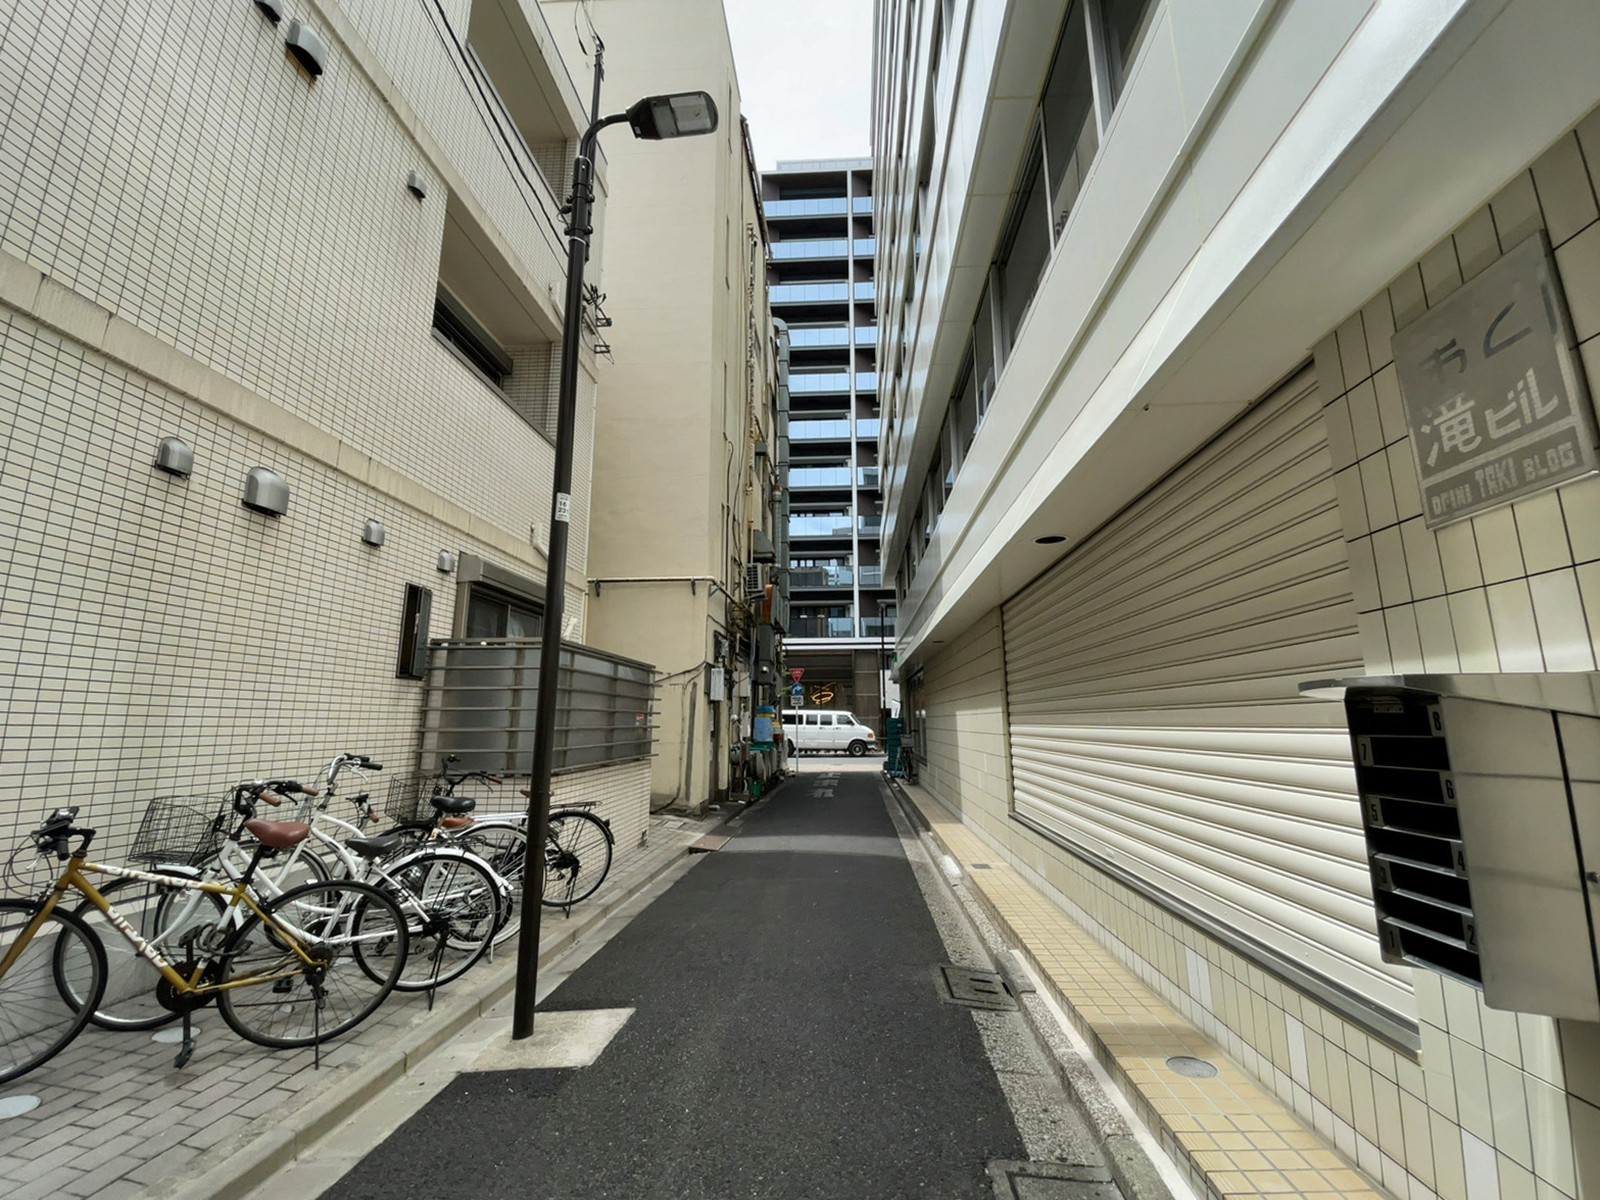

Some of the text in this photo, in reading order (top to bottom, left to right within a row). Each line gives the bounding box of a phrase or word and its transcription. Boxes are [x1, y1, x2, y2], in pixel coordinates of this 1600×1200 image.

[1420, 367, 1559, 468] 滝ビル
[1474, 456, 1519, 498] TAKI
[1432, 711, 1442, 731] 8
[1360, 743, 1367, 761] 7
[1445, 779, 1455, 800] 6
[1371, 804, 1379, 822] 5
[1457, 850, 1466, 871] 4
[1379, 865, 1388, 885] 3
[1388, 929, 1396, 949] 1
[1466, 924, 1477, 947] 2
